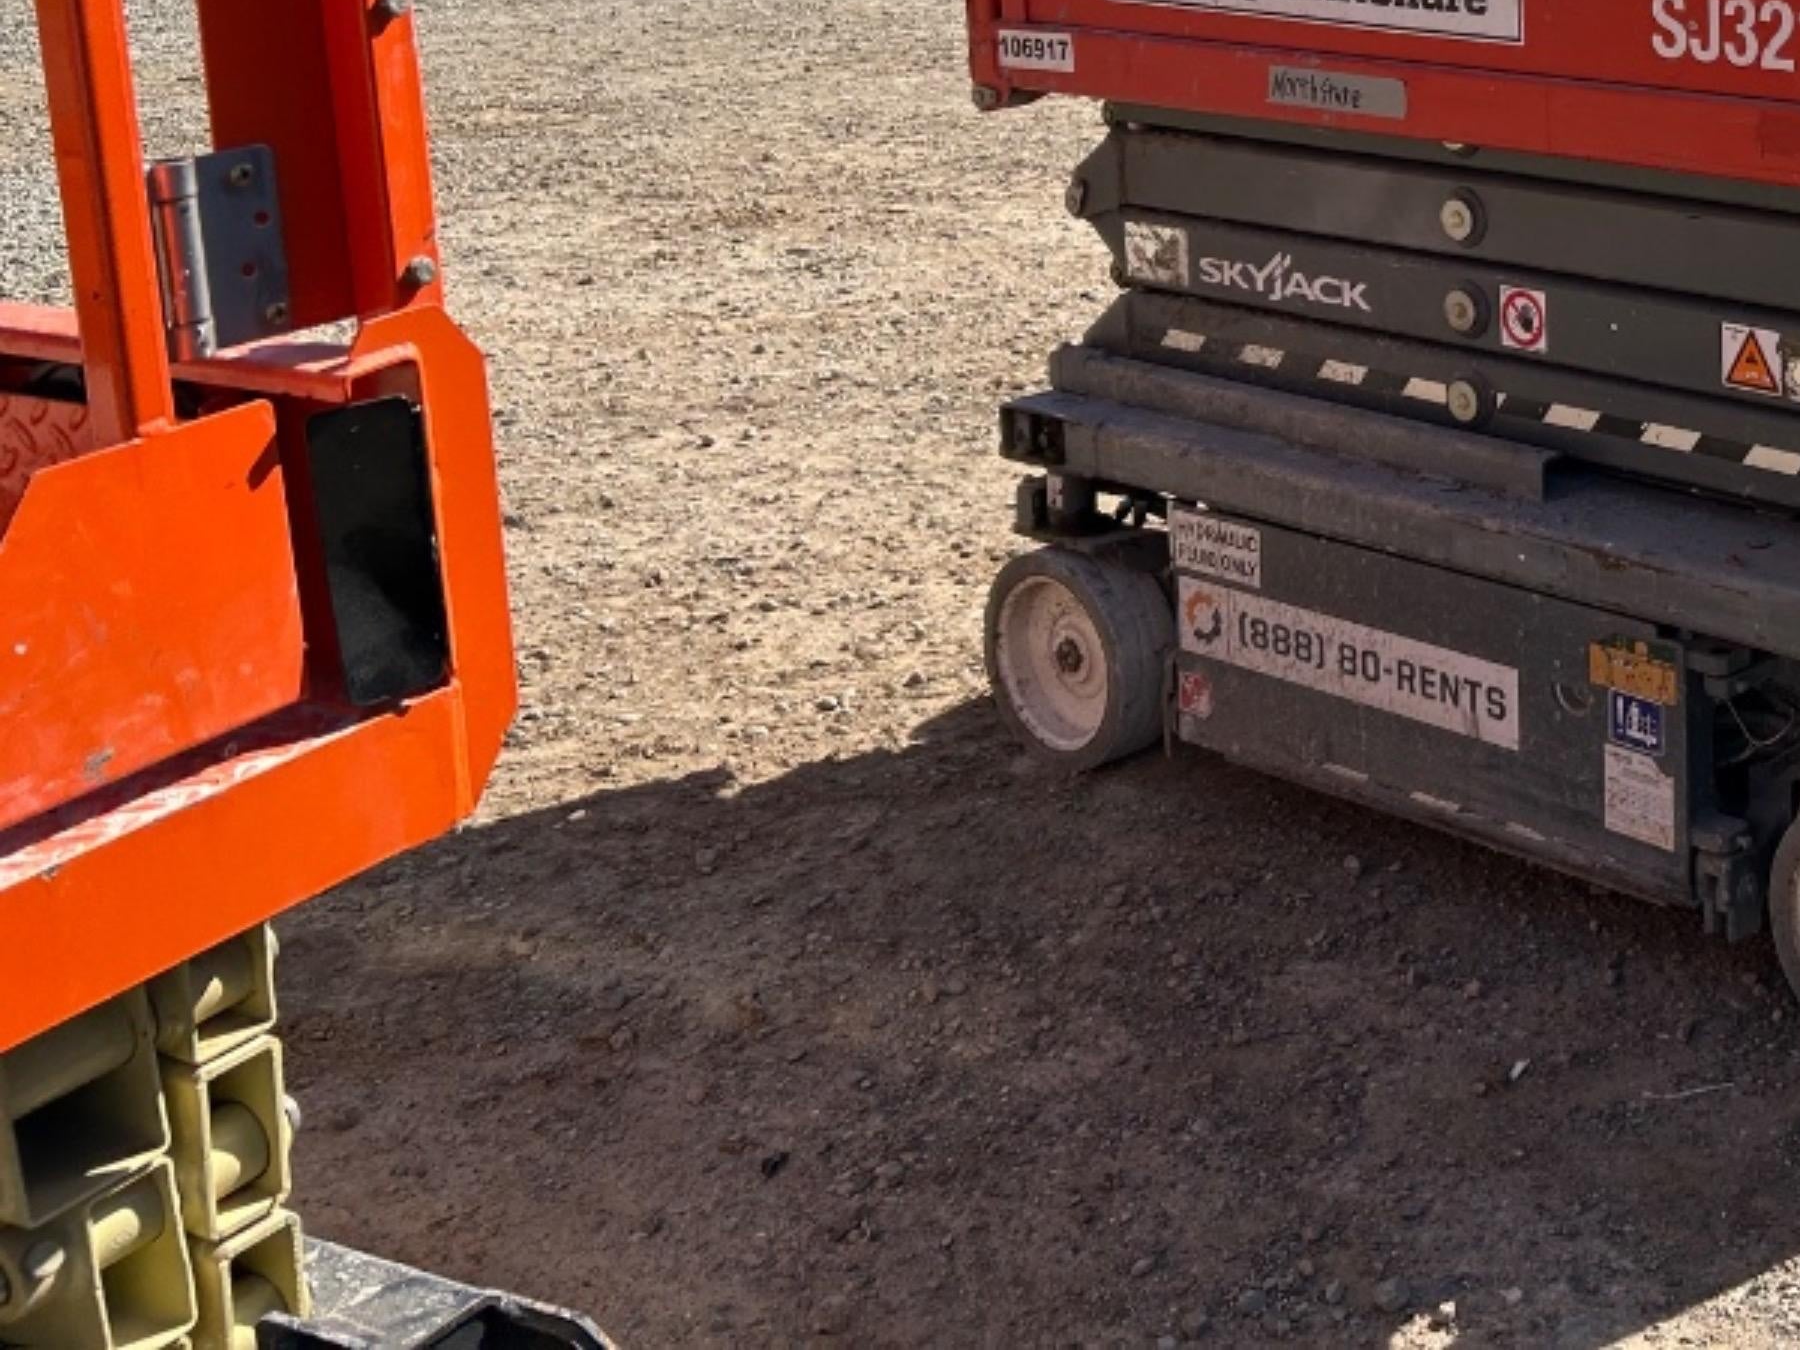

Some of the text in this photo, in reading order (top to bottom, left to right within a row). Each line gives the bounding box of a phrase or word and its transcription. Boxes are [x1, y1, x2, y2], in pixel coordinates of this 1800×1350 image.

[998, 34, 1070, 64] 106917
[1198, 252, 1372, 313] SKYJACK
[1237, 615, 1508, 721] (888) 80-RENTS
